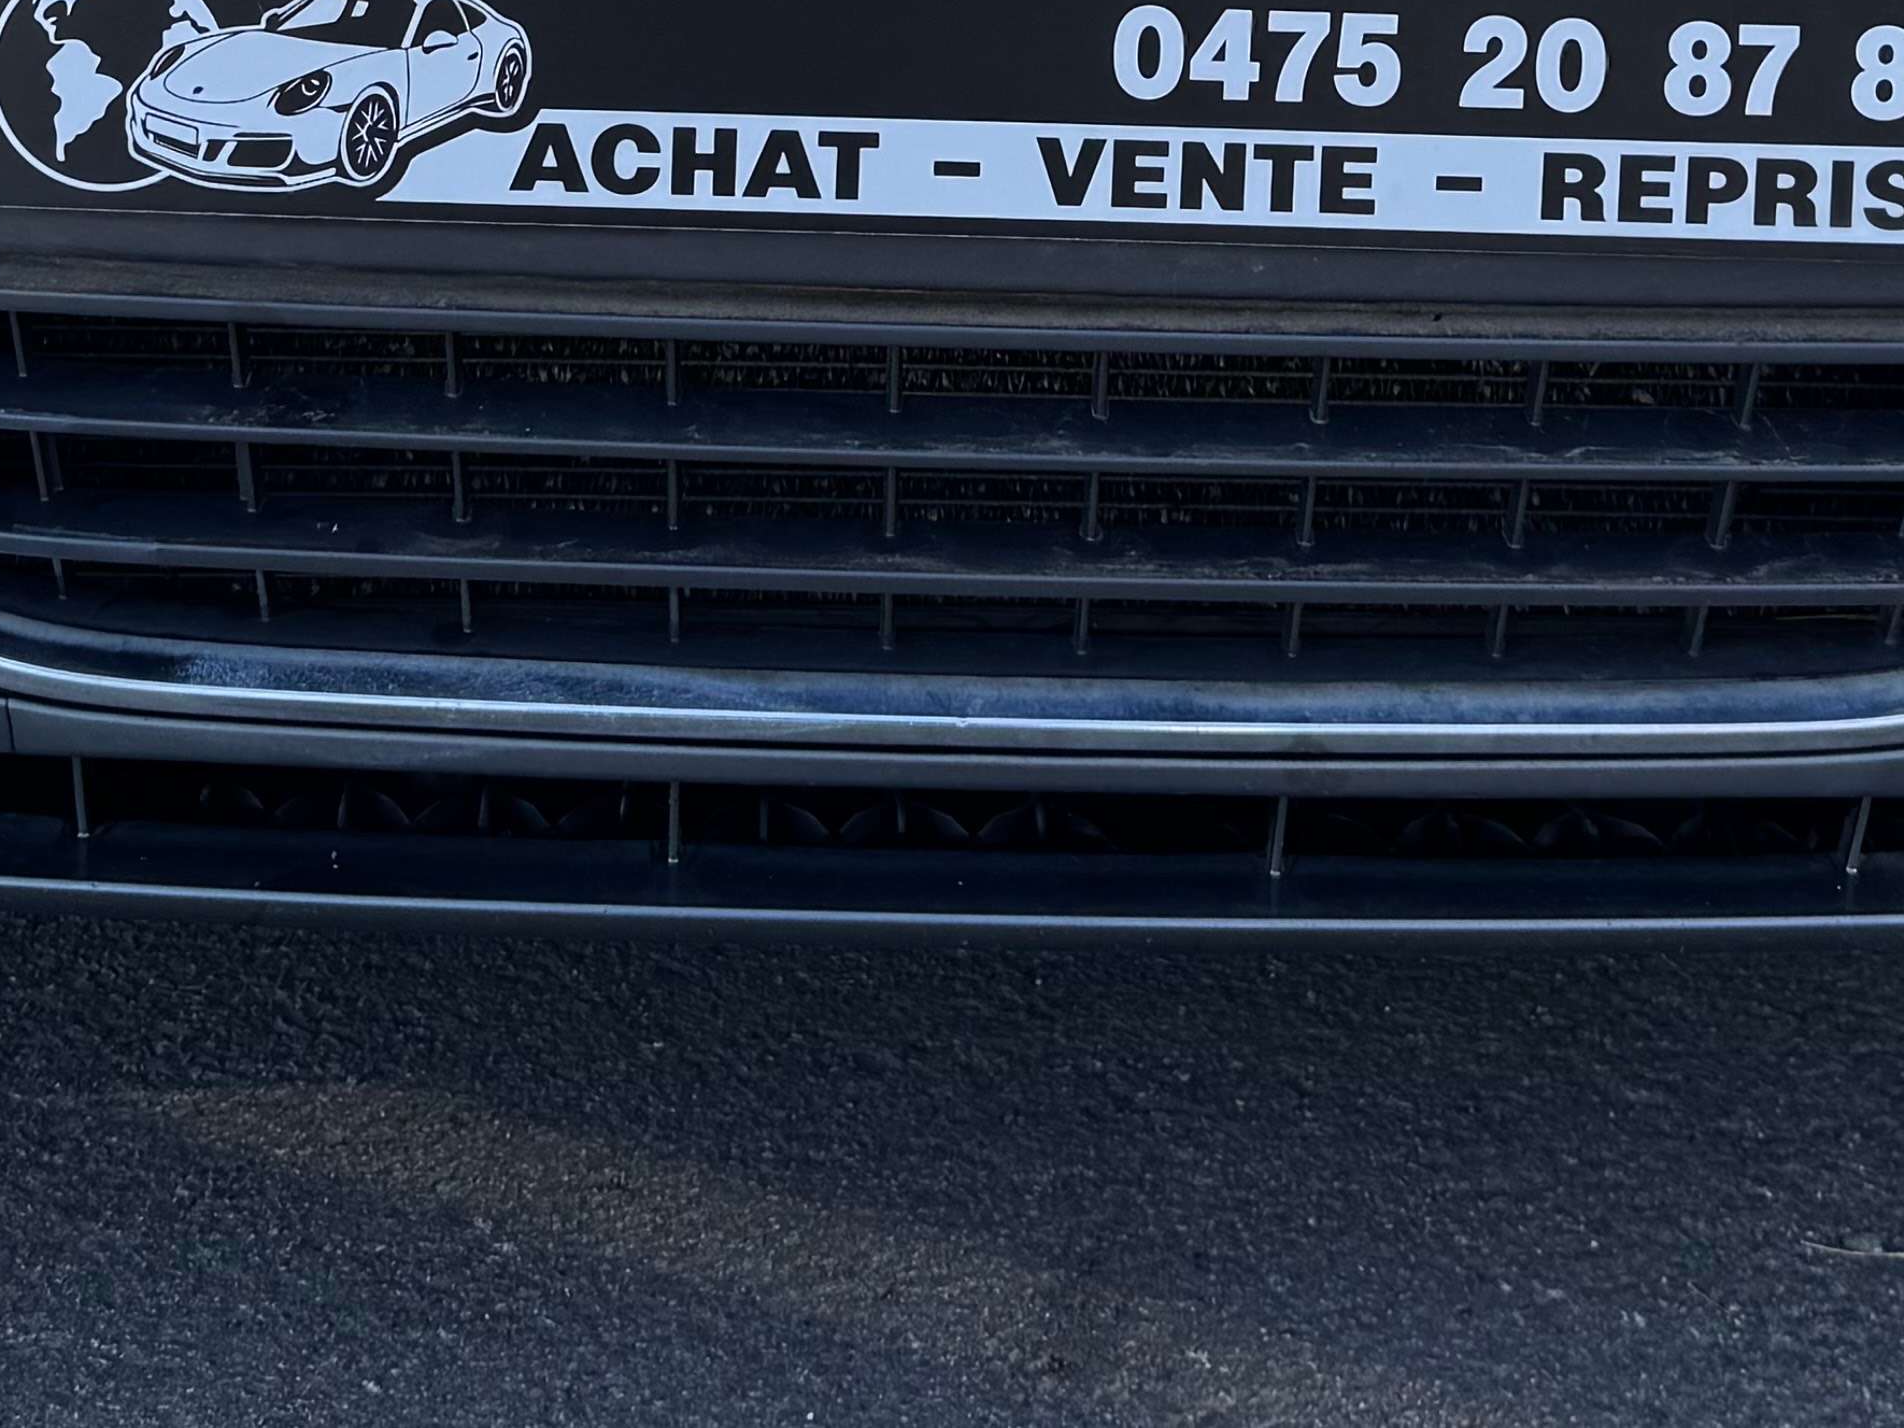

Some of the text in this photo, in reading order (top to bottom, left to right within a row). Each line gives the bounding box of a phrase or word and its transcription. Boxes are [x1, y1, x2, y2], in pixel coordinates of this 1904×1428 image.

[1112, 3, 1403, 108] 0475
[1457, 13, 1608, 115] 20
[1662, 19, 1802, 118] 87
[507, 121, 881, 202] ACHAT
[1035, 135, 1379, 217] VENTE
